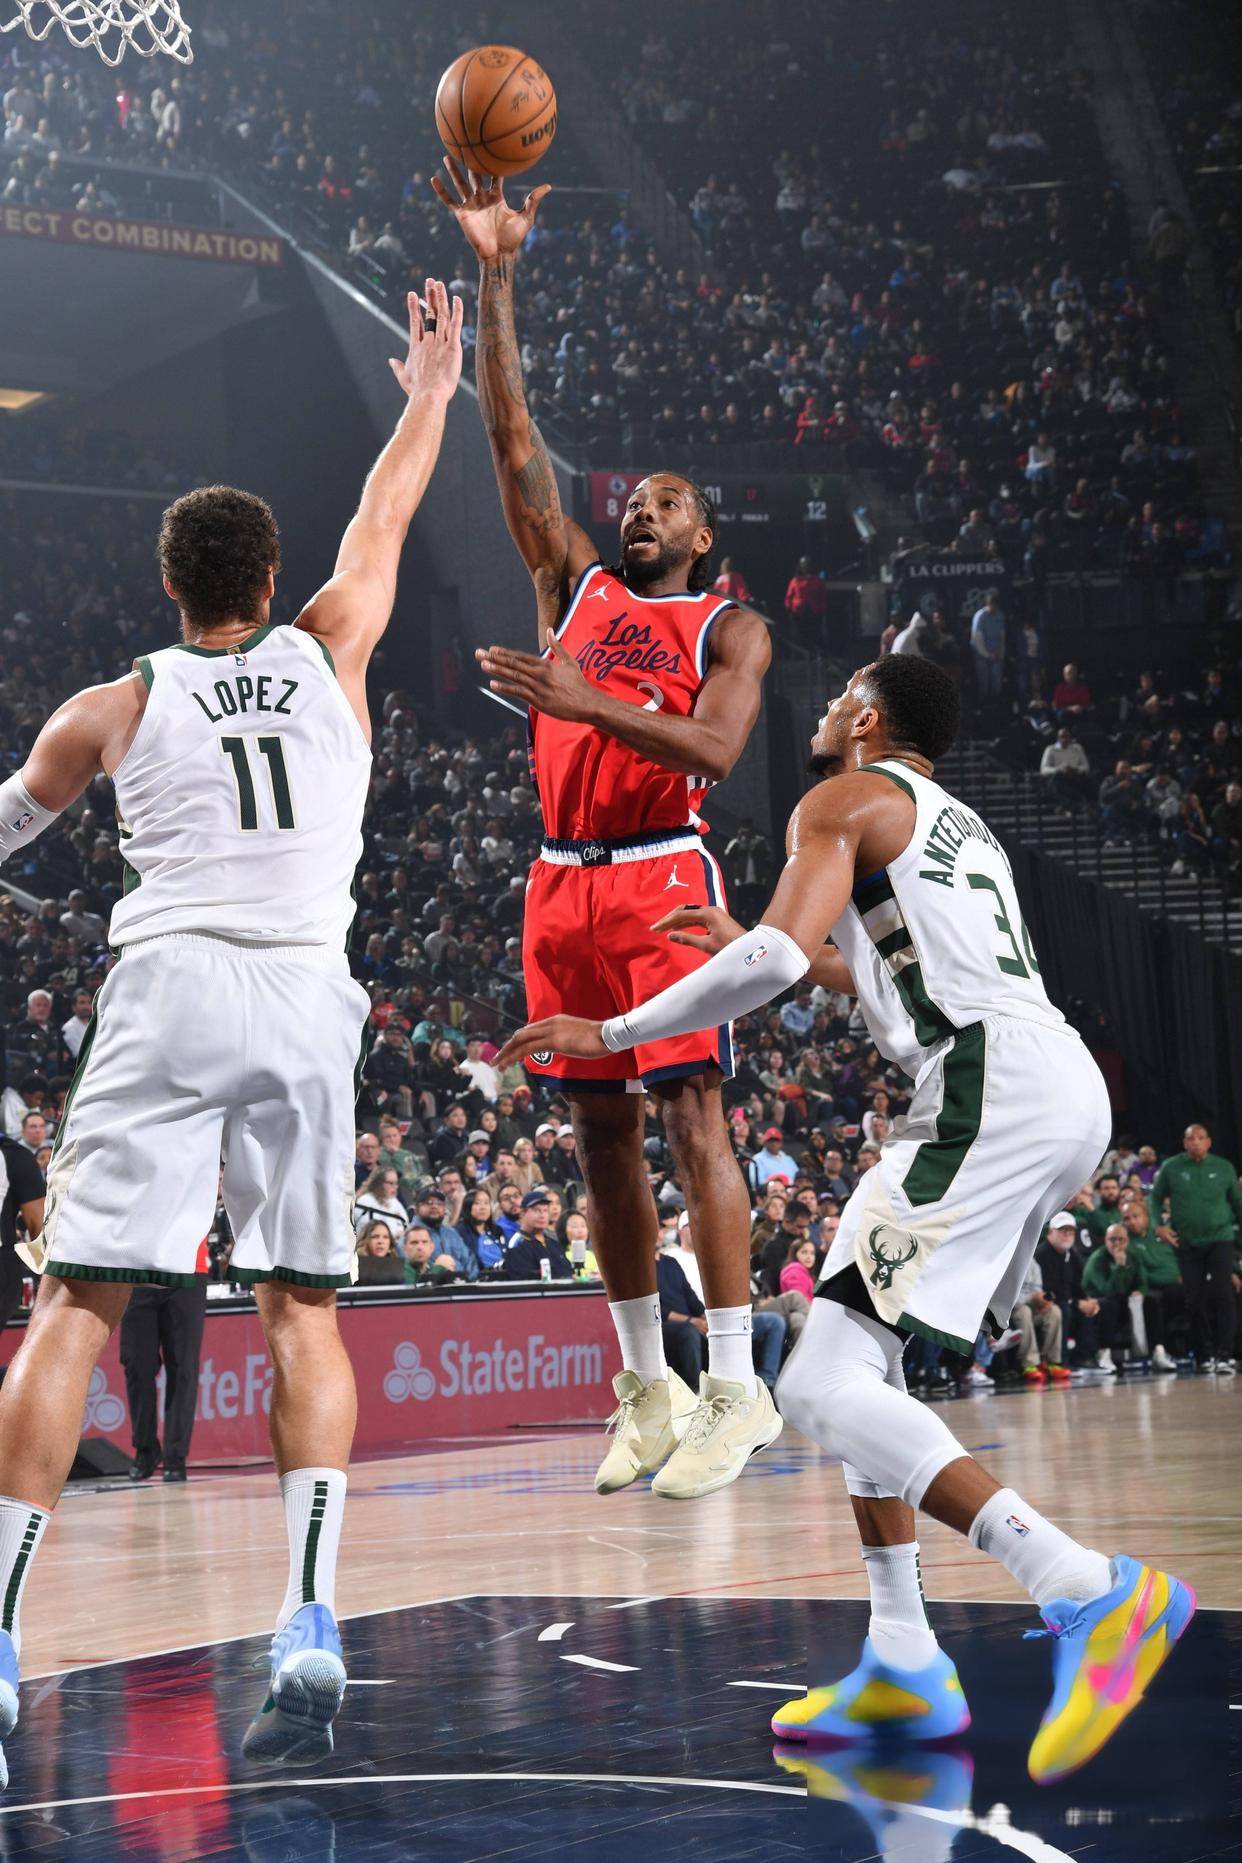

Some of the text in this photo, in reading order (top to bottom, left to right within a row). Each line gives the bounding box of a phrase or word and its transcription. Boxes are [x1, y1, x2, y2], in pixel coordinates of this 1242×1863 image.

[0, 207, 279, 262] ECT COMBINATION
[806, 501, 827, 520] 12
[910, 561, 1005, 577] LA CLIPPERS
[600, 611, 652, 647] Los
[575, 639, 681, 681] Angeles
[192, 675, 299, 723] LOPEZ
[219, 735, 296, 831] 11
[583, 845, 606, 861] Clips
